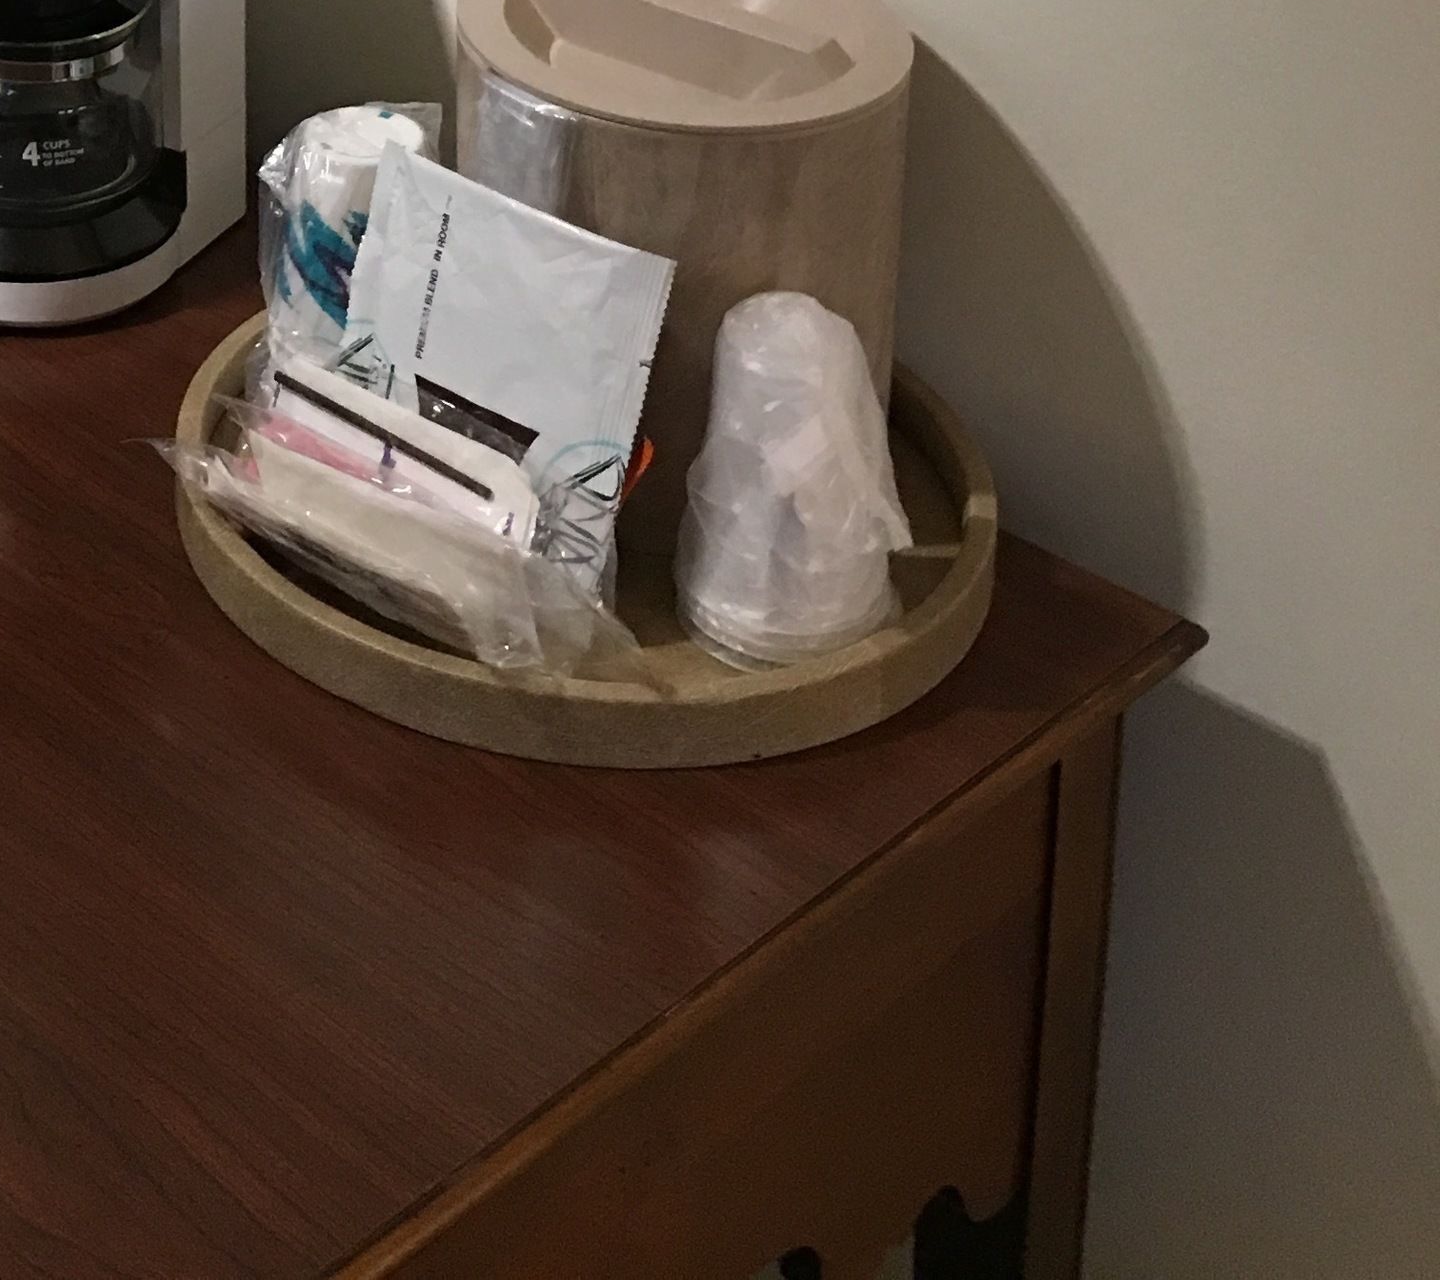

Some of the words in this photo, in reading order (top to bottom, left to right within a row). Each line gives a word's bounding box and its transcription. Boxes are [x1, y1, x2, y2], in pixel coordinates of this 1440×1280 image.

[22, 141, 40, 166] 4
[42, 139, 71, 151] CUPS
[437, 213, 451, 249] ROOM
[433, 249, 443, 262] IN
[424, 269, 439, 307] BLEND
